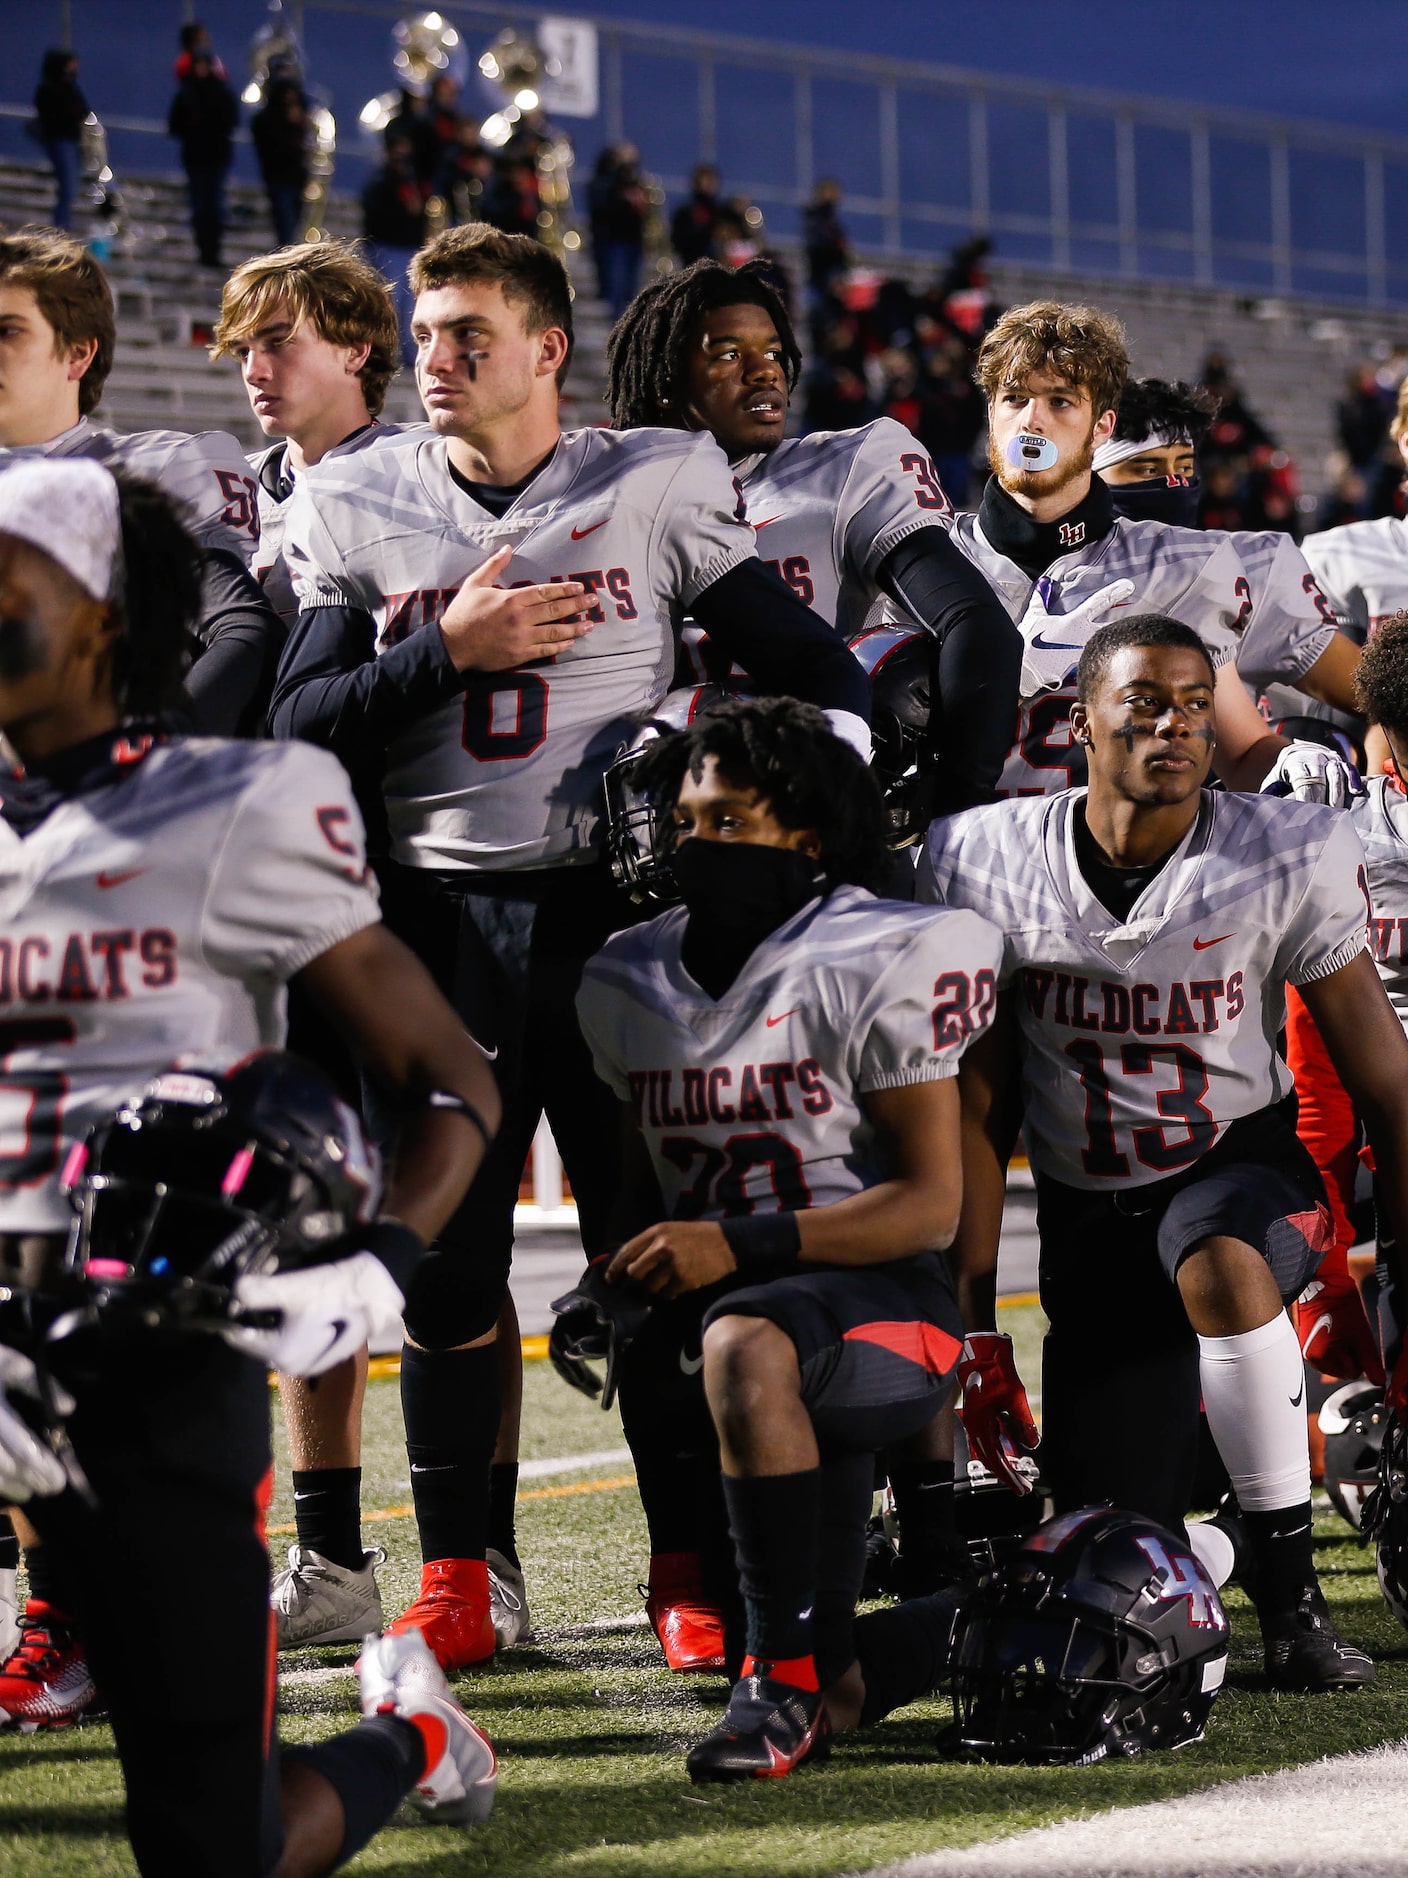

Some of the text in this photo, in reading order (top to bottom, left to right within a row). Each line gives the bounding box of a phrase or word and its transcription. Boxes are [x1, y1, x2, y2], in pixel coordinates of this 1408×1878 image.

[1059, 522, 1085, 546] LH
[933, 969, 998, 1052] 20
[1022, 968, 1245, 1036] WILDCATS
[628, 1057, 834, 1129] WILDCATS
[1064, 1037, 1220, 1179] 13
[290, 1614, 349, 1642] adidas
